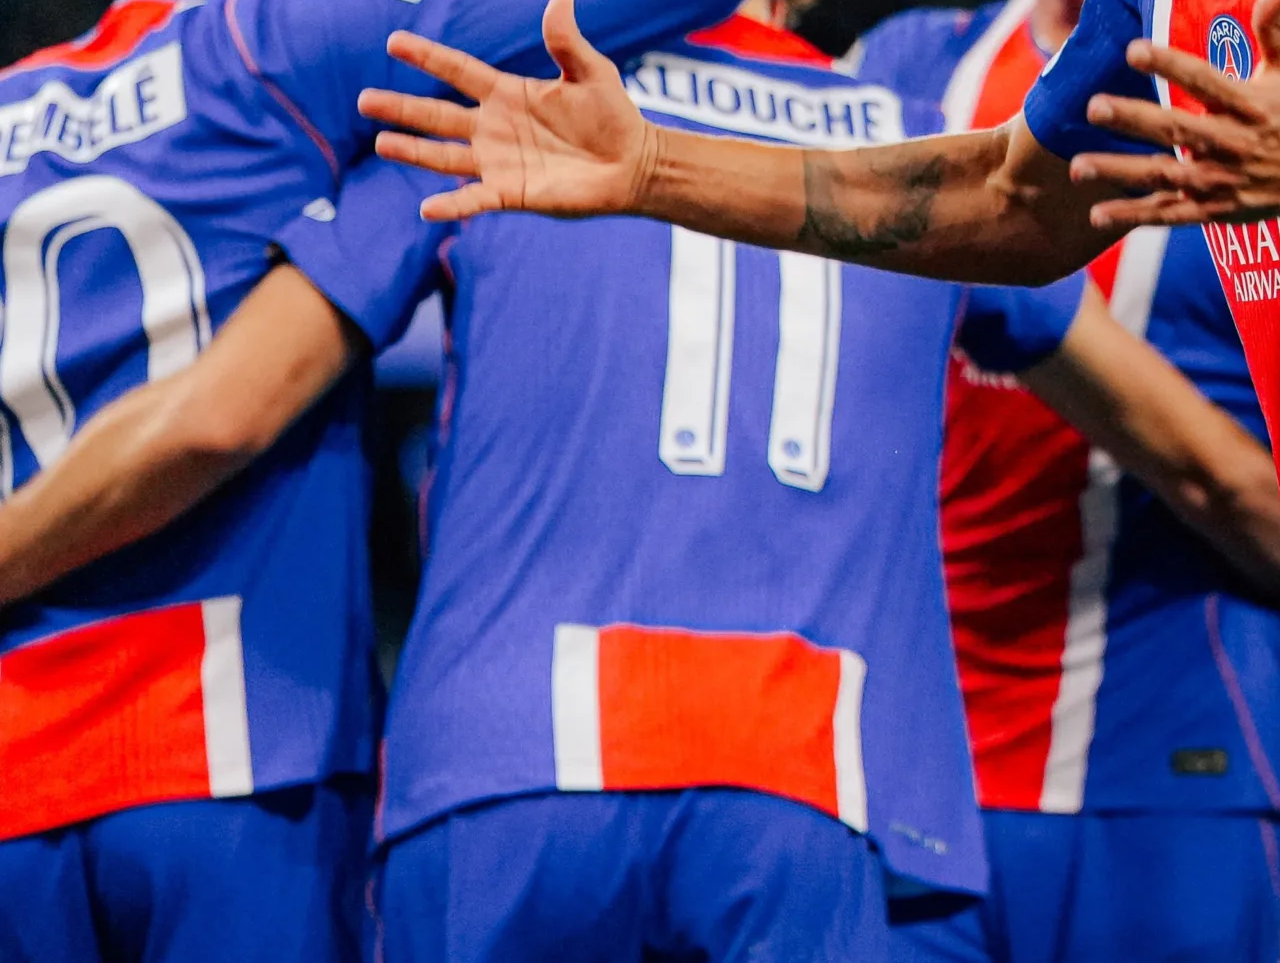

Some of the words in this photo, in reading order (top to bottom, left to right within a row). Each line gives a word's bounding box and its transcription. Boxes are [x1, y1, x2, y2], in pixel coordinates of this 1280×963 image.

[1212, 22, 1241, 46] PARIS
[0, 175, 213, 499] 0
[658, 225, 843, 493] 11
